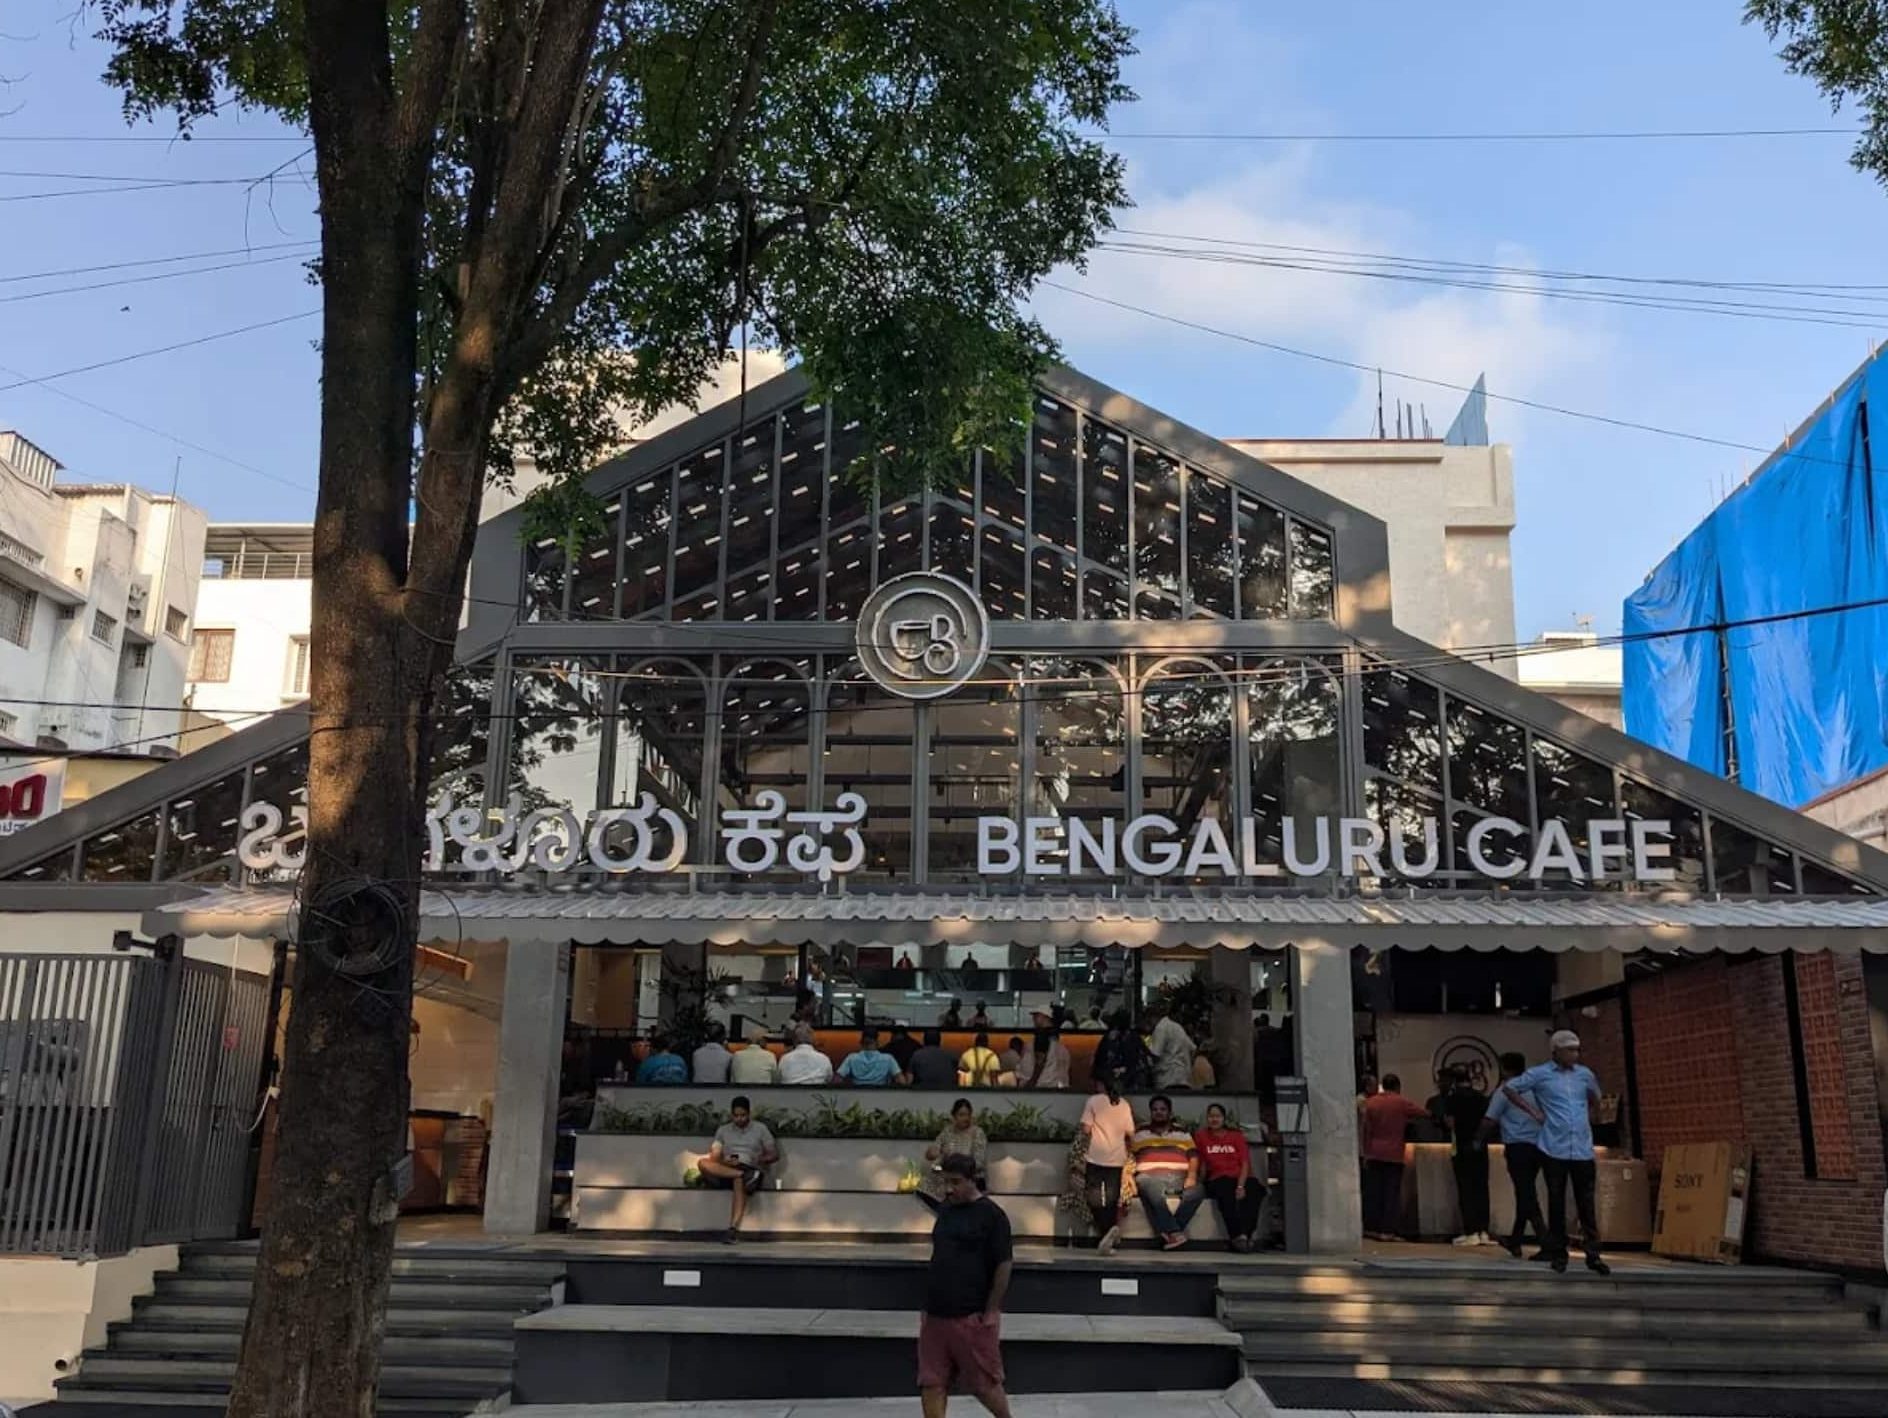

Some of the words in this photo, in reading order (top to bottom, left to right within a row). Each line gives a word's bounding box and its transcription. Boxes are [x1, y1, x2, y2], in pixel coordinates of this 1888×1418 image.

[721, 789, 867, 882] ಕೆಫೆ
[978, 814, 1439, 877] BENGALURU
[1467, 817, 1675, 881] CAFE
